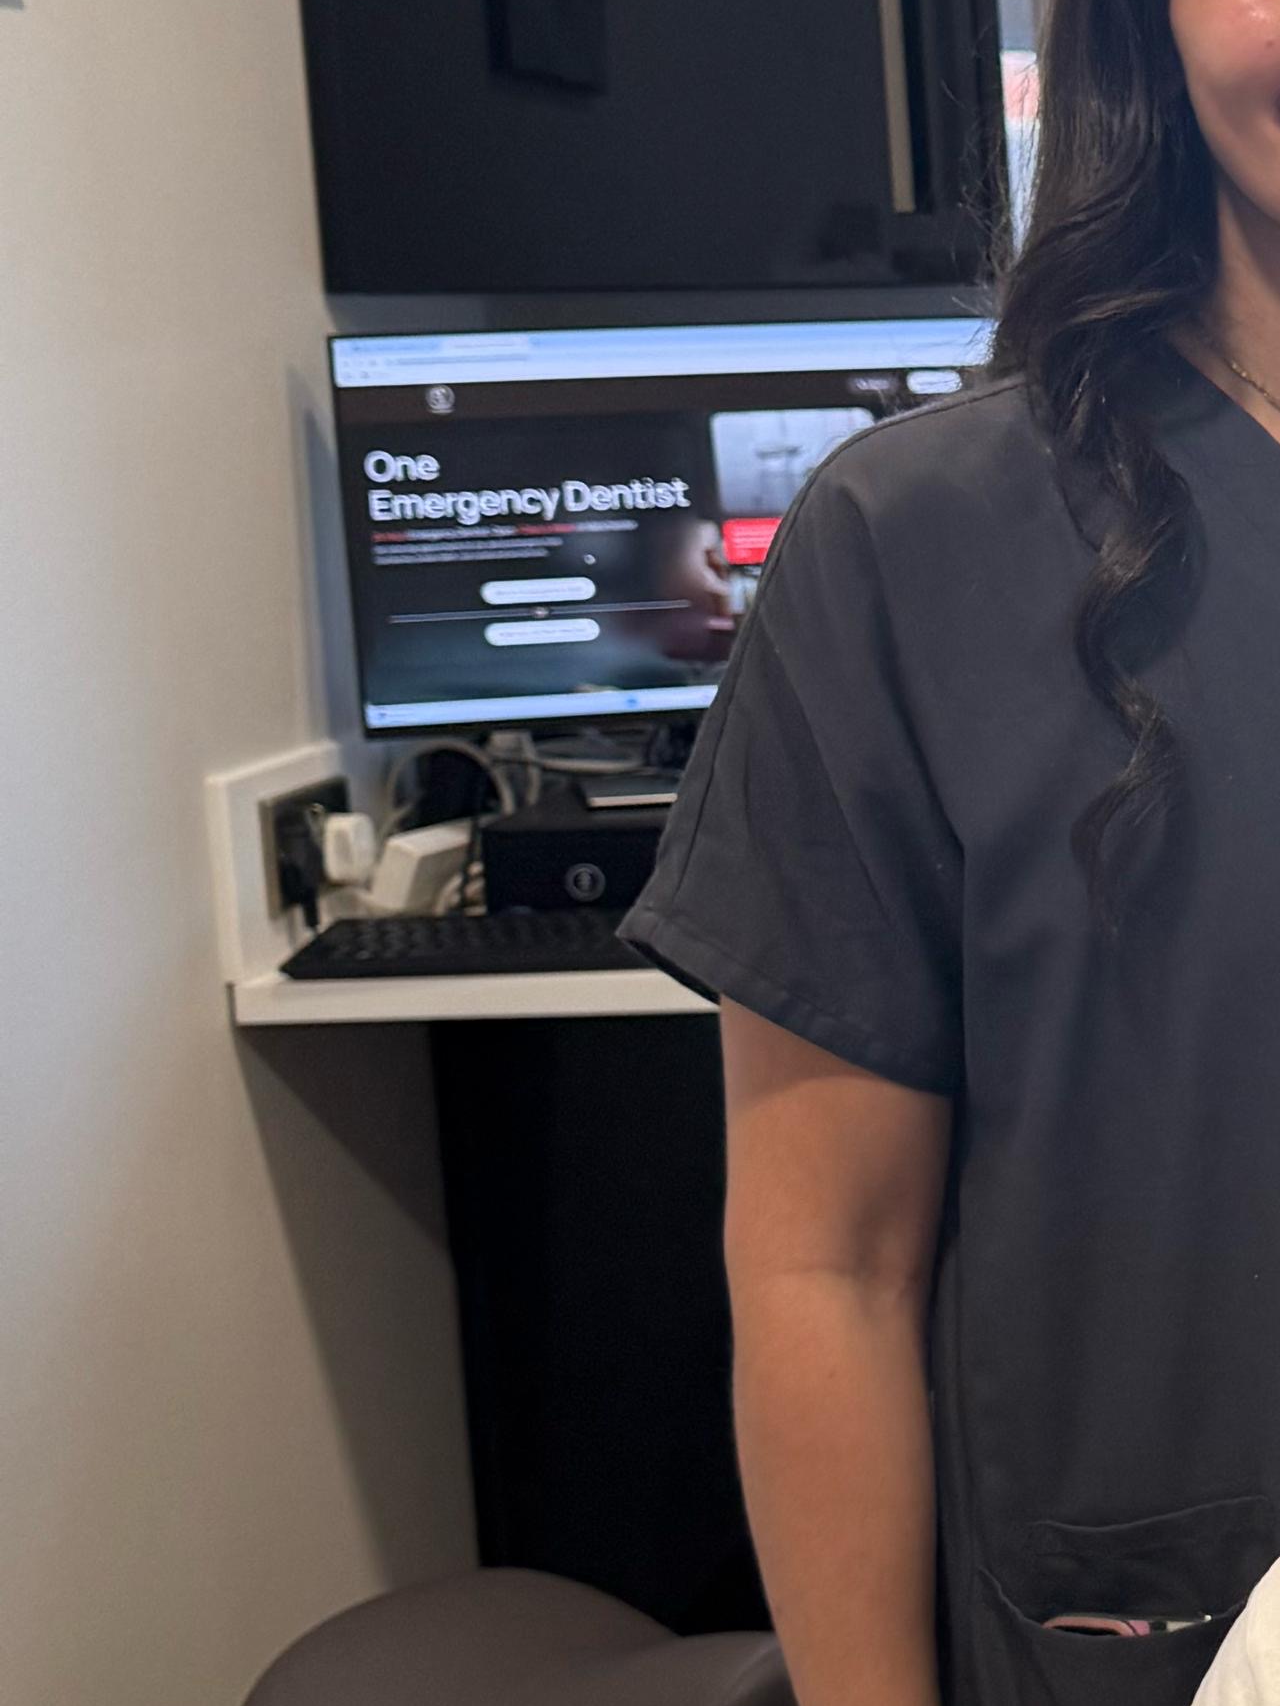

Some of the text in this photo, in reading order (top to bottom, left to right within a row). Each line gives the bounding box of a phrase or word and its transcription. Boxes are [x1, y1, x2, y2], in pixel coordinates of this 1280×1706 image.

[364, 450, 440, 483] One
[367, 477, 692, 525] Emergency Dentist
